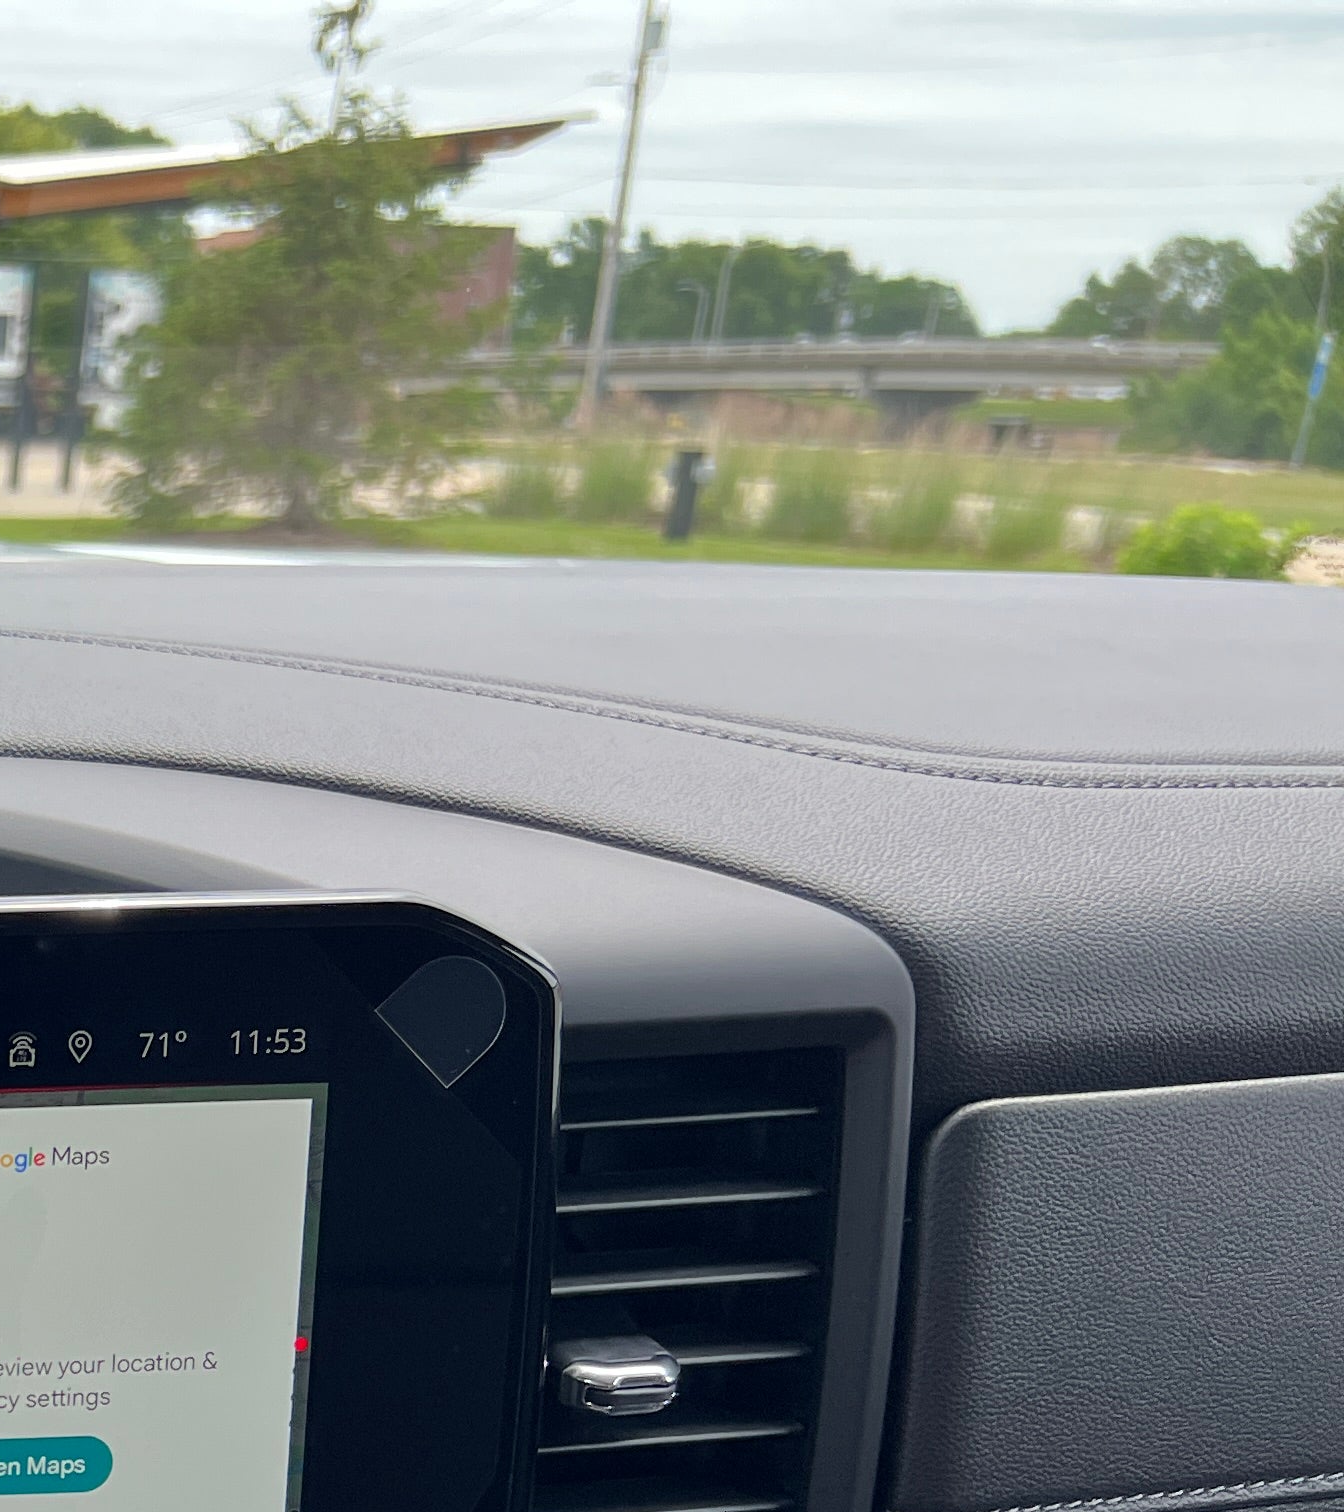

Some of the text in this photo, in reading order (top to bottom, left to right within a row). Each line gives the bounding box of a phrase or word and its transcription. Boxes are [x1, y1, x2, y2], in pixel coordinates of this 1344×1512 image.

[230, 1028, 306, 1055] 11:53
[51, 1146, 110, 1170] Maps
[57, 1359, 106, 1380] your
[111, 1351, 196, 1374] location
[202, 1351, 218, 1370] &
[25, 1387, 111, 1412] settings
[26, 1455, 86, 1479] Maps
